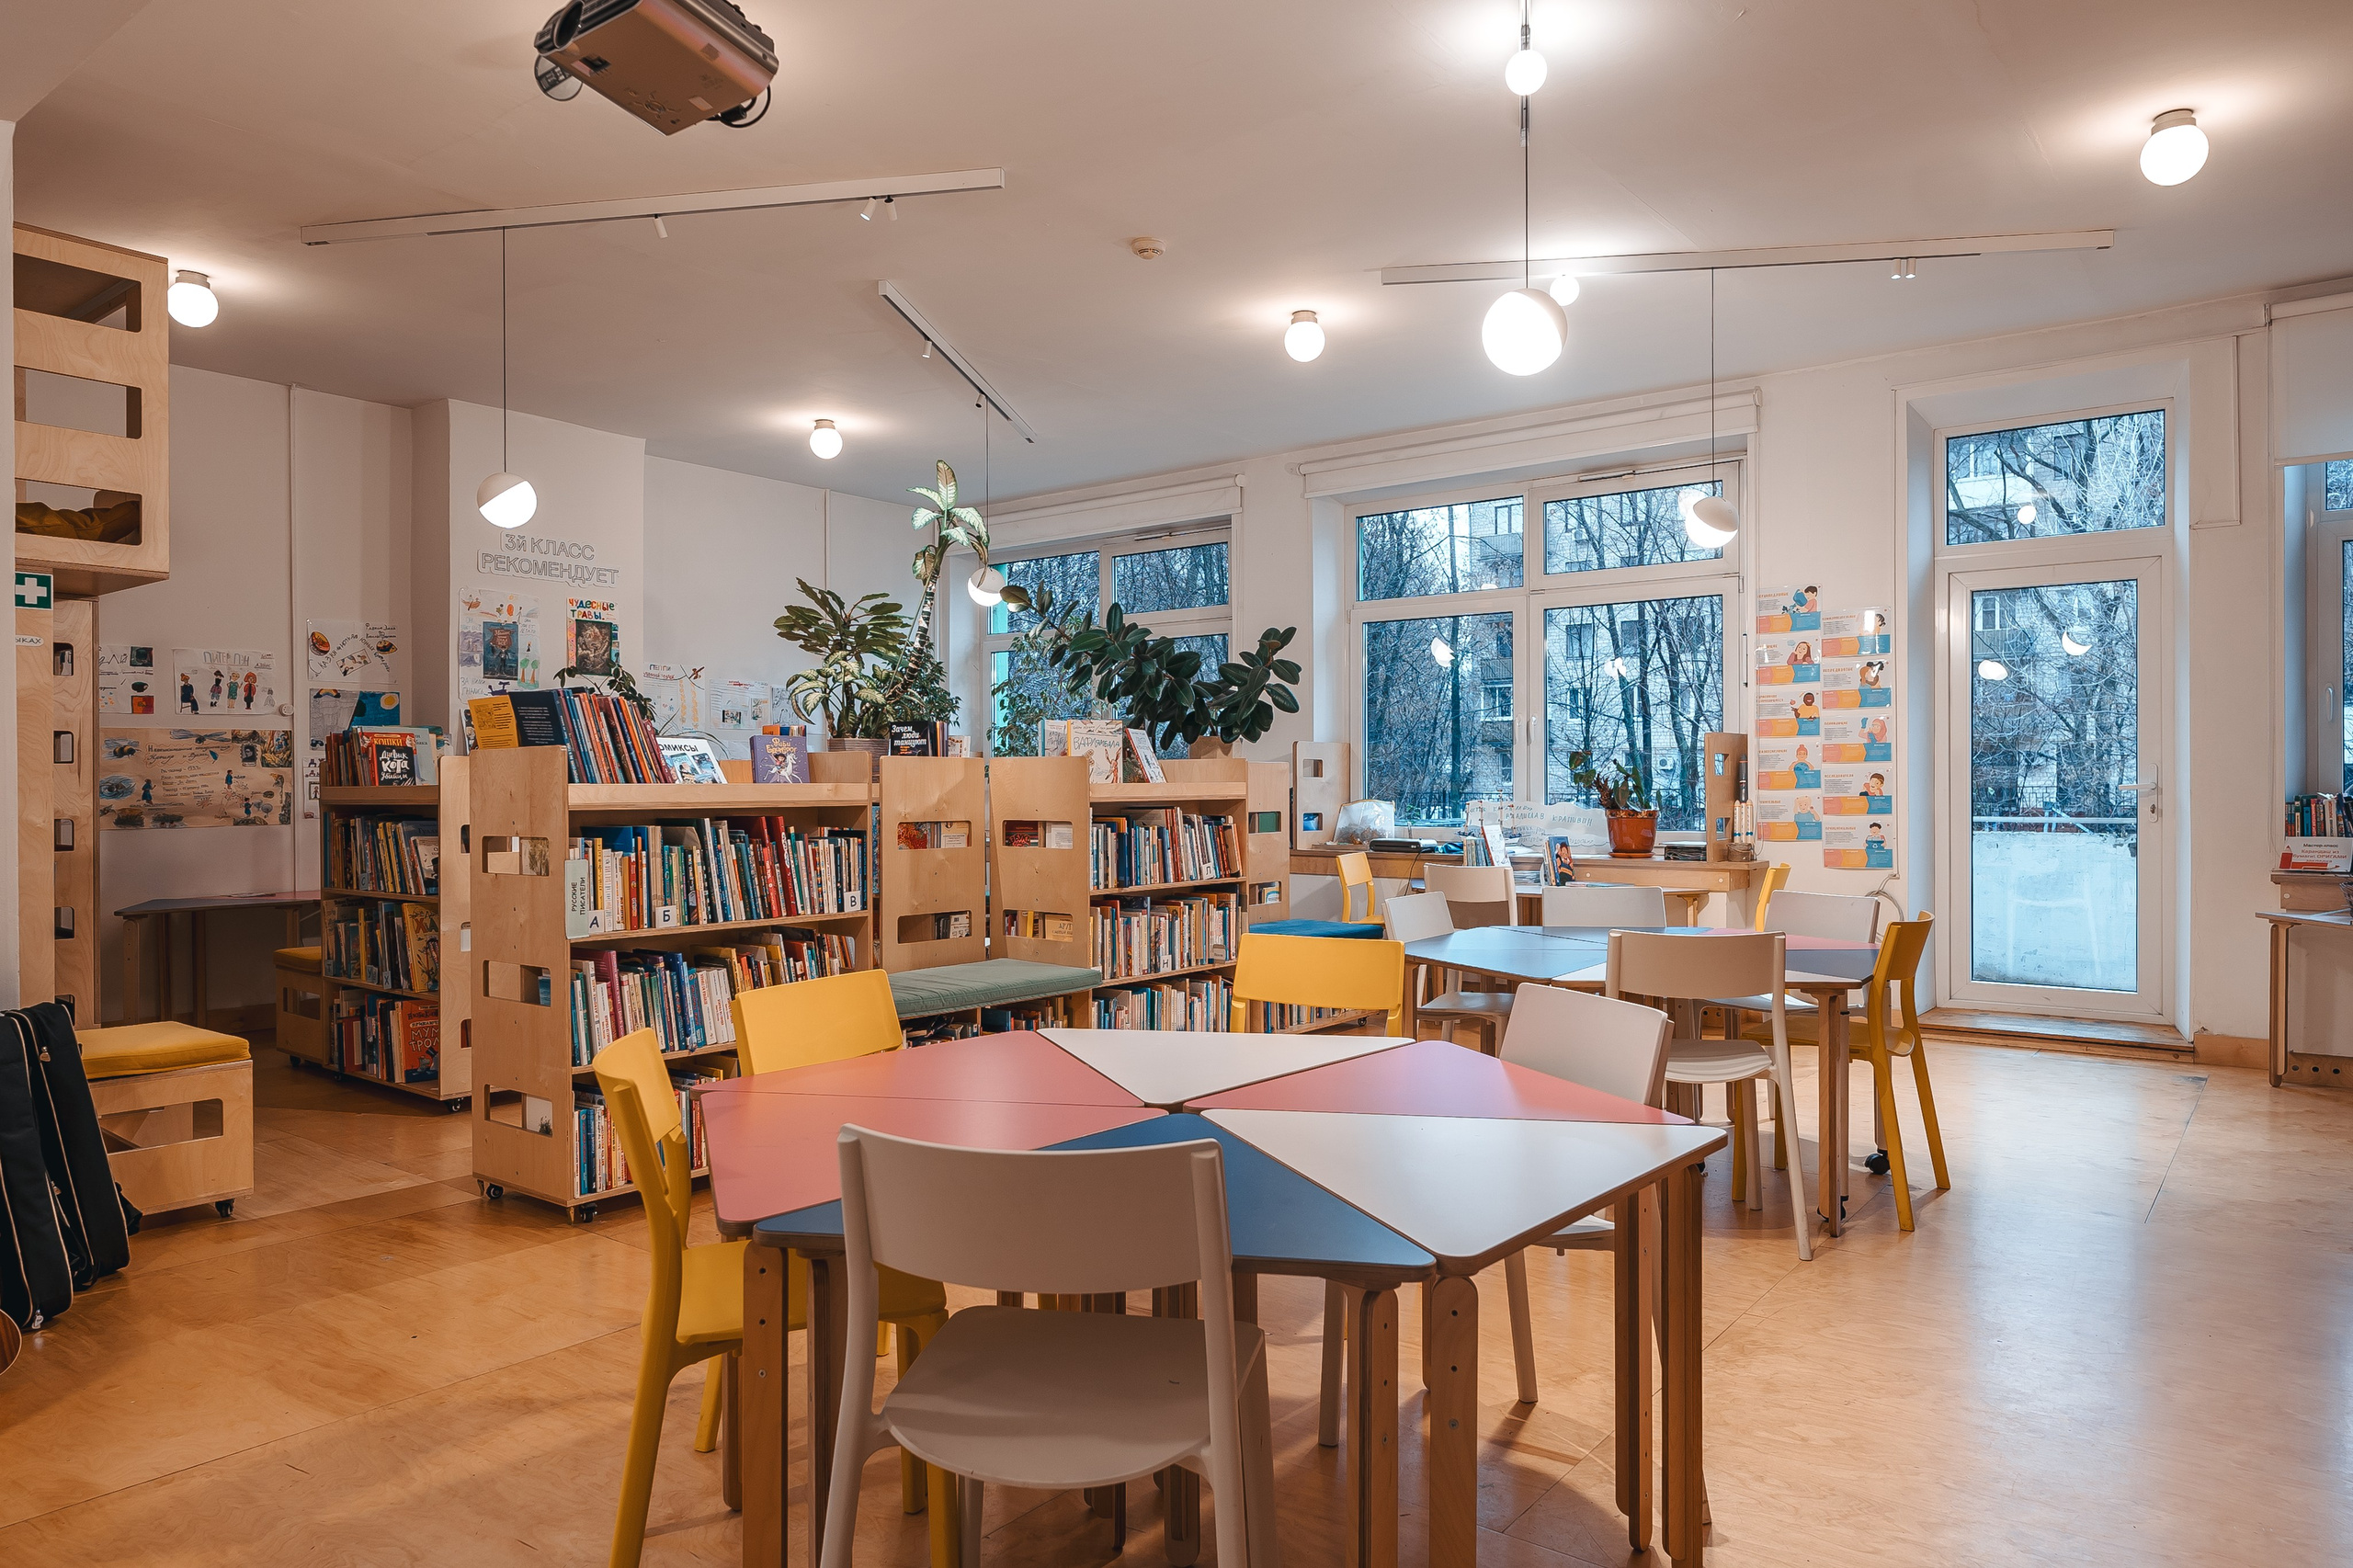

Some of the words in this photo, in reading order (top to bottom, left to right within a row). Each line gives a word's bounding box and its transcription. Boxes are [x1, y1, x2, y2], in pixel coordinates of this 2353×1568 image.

[506, 533, 527, 551] 3й
[531, 537, 595, 561] КЛАСС
[482, 552, 619, 584] РЕКОМЕНДУЕТ
[203, 651, 231, 664] ПИТЕР
[233, 653, 250, 665] ПЭН
[892, 724, 913, 733] Зачем
[902, 731, 919, 739] люди
[374, 738, 403, 746] КОШКИ
[894, 739, 926, 747] танцуют
[658, 744, 699, 752] ОМИКСЫ
[850, 895, 858, 906] В
[589, 915, 599, 928] А
[663, 910, 671, 922] Б
